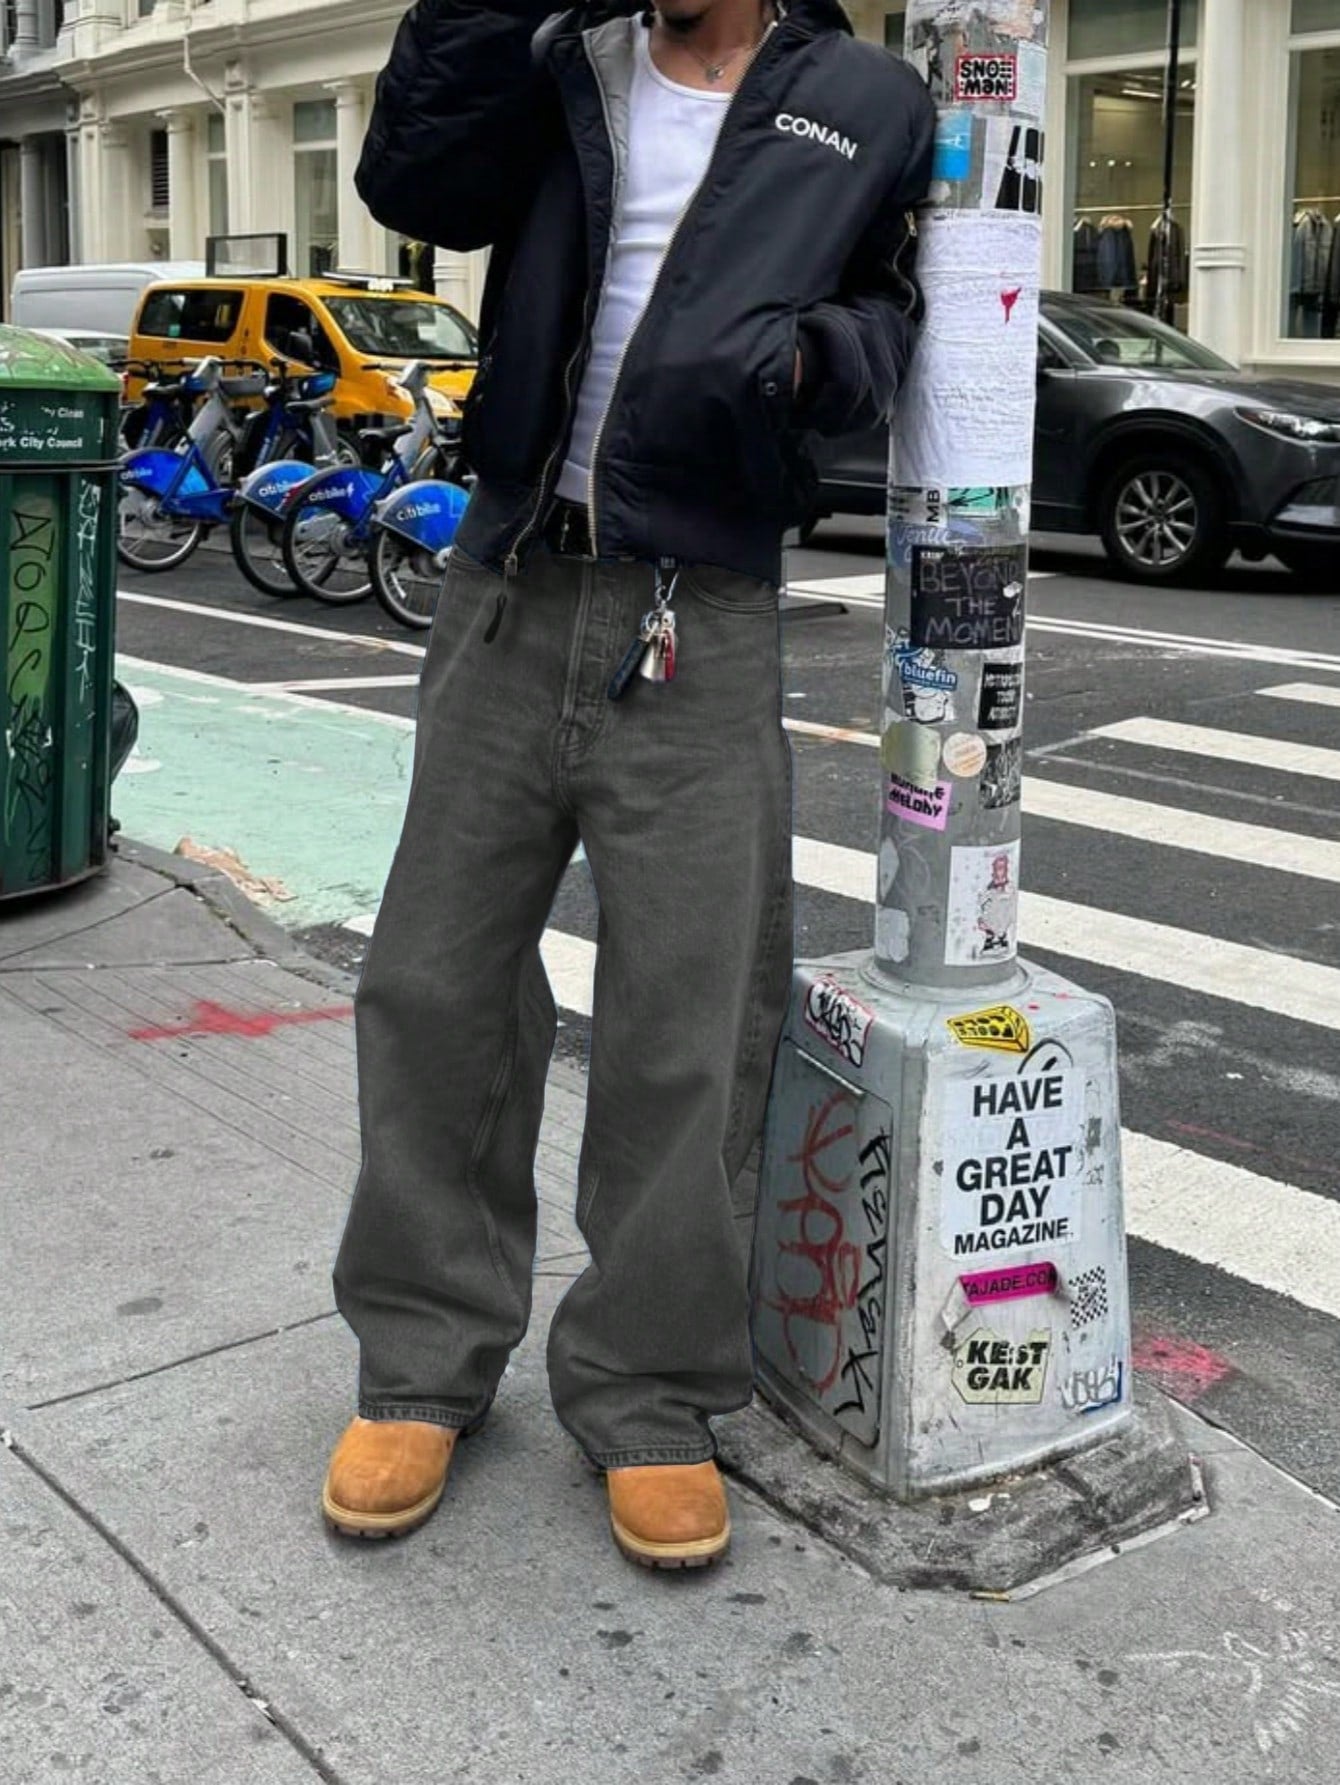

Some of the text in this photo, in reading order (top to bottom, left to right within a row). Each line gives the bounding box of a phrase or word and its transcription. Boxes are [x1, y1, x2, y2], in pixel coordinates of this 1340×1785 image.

[775, 113, 858, 160] CONAN
[20, 436, 44, 450] City
[944, 596, 996, 616] THE
[903, 662, 956, 685] bluefin
[973, 1076, 1063, 1117] HAVE
[1006, 1117, 1030, 1150] A
[956, 1145, 1072, 1192] GREAT
[980, 1185, 1050, 1227] DAY
[954, 1217, 1068, 1255] MAGAZINE
[967, 1367, 1033, 1390] GAK
